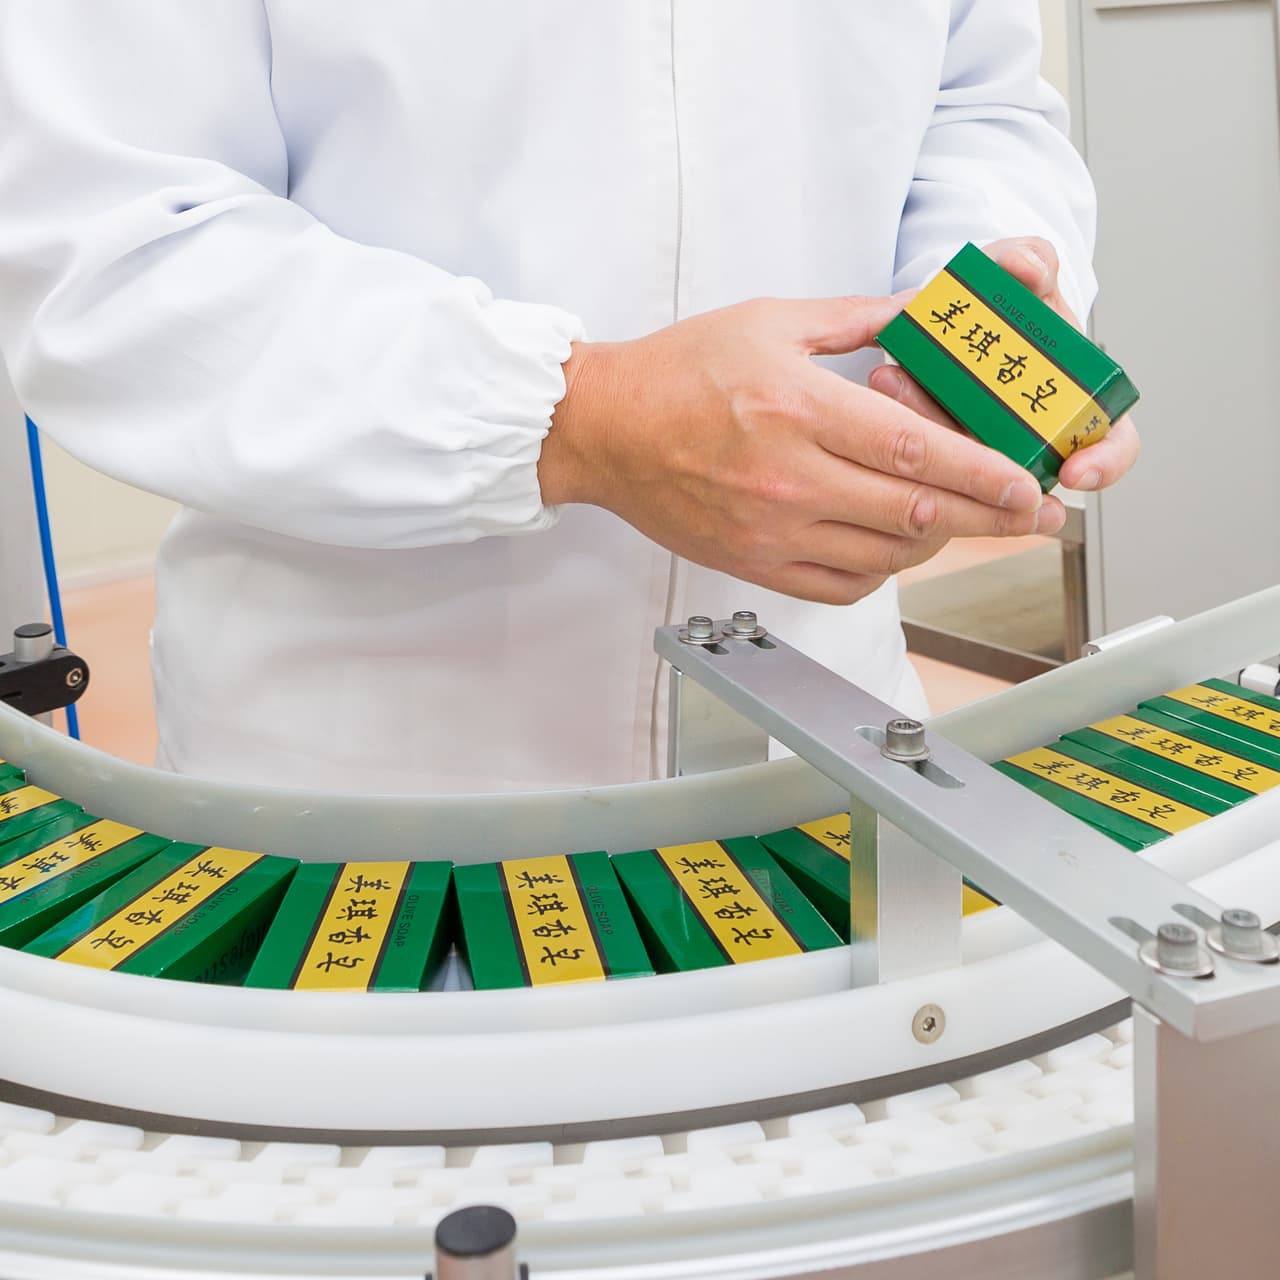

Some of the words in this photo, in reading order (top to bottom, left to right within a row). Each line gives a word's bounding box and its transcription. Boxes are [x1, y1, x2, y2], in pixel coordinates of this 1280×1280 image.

[992, 294, 1025, 322] OLIVE
[1026, 322, 1057, 349] SOAP
[929, 300, 1057, 413] 美琪香皂
[1117, 727, 1260, 782] 美琪香皂
[1032, 760, 1176, 820] 美琪香皂
[90, 860, 228, 950] 美琪香皂
[316, 874, 391, 973] 美琪香皂
[403, 894, 420, 919] OLIVE
[515, 871, 585, 966] 美琪香皂
[587, 884, 604, 910] OLIVE
[596, 911, 614, 936] SOAP
[679, 856, 775, 945] 美琪香皂
[394, 919, 411, 948] SOAP
